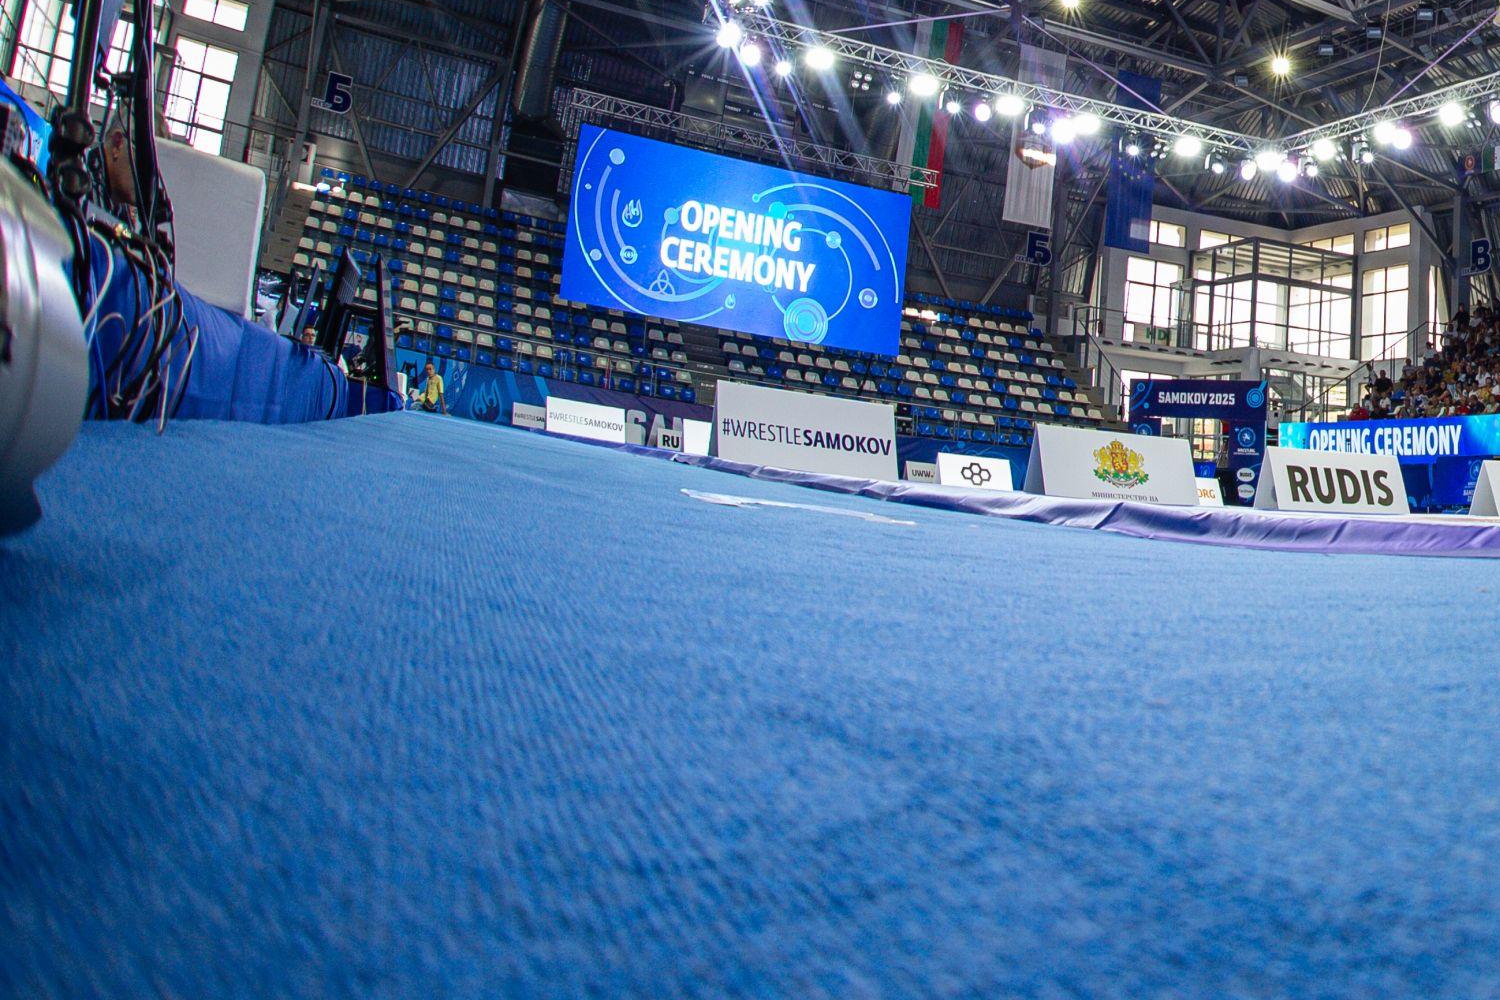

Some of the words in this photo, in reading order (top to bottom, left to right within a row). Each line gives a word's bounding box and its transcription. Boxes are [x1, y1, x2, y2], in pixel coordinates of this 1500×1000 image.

[680, 200, 803, 252] OPENING
[660, 236, 816, 293] CEREMONY
[1158, 391, 1208, 405] SAMOKOV
[1208, 393, 1236, 405] 2025
[549, 411, 624, 432] #WRESTLESAMOKOV
[722, 417, 892, 456] #WRESTLESAMOKOV
[1309, 427, 1371, 456] OPENING
[1374, 424, 1462, 457] CEREMONY
[911, 468, 934, 478] UWW.
[1286, 465, 1394, 507] RUDIS
